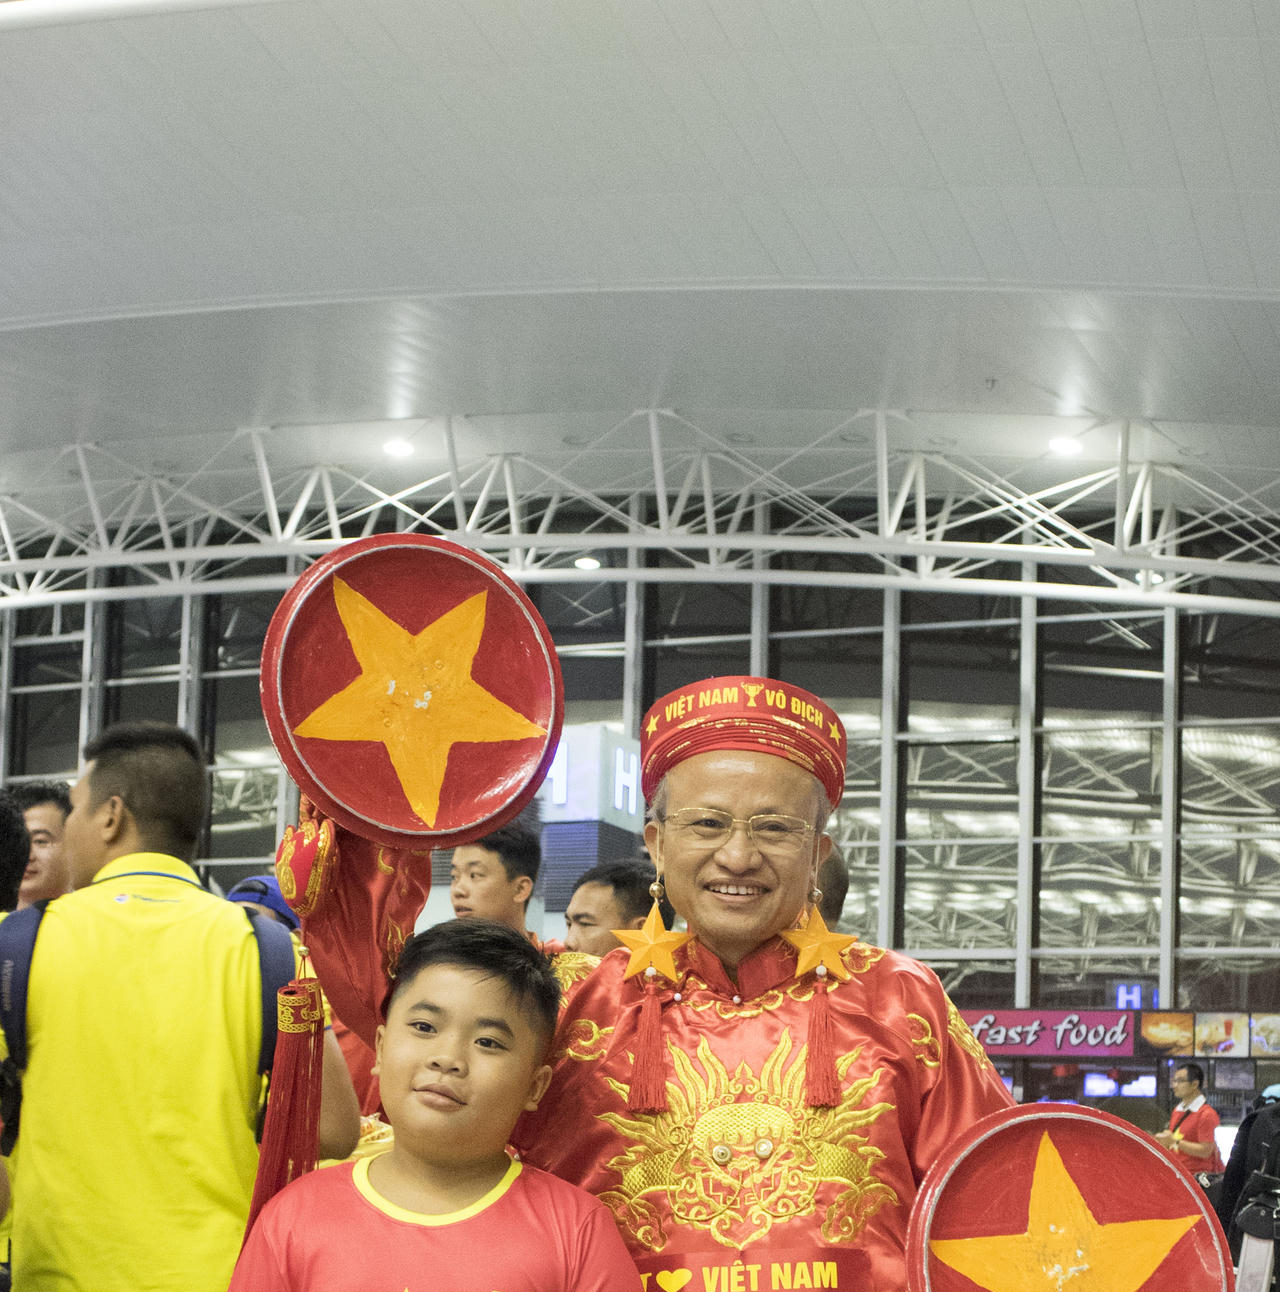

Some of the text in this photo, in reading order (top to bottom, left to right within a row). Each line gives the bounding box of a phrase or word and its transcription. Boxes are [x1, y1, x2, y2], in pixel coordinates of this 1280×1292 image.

[665, 687, 824, 729] VIỆT NAM VÔ ĐỊCH
[970, 1013, 1129, 1050] fast food
[770, 1261, 838, 1290] NAM
